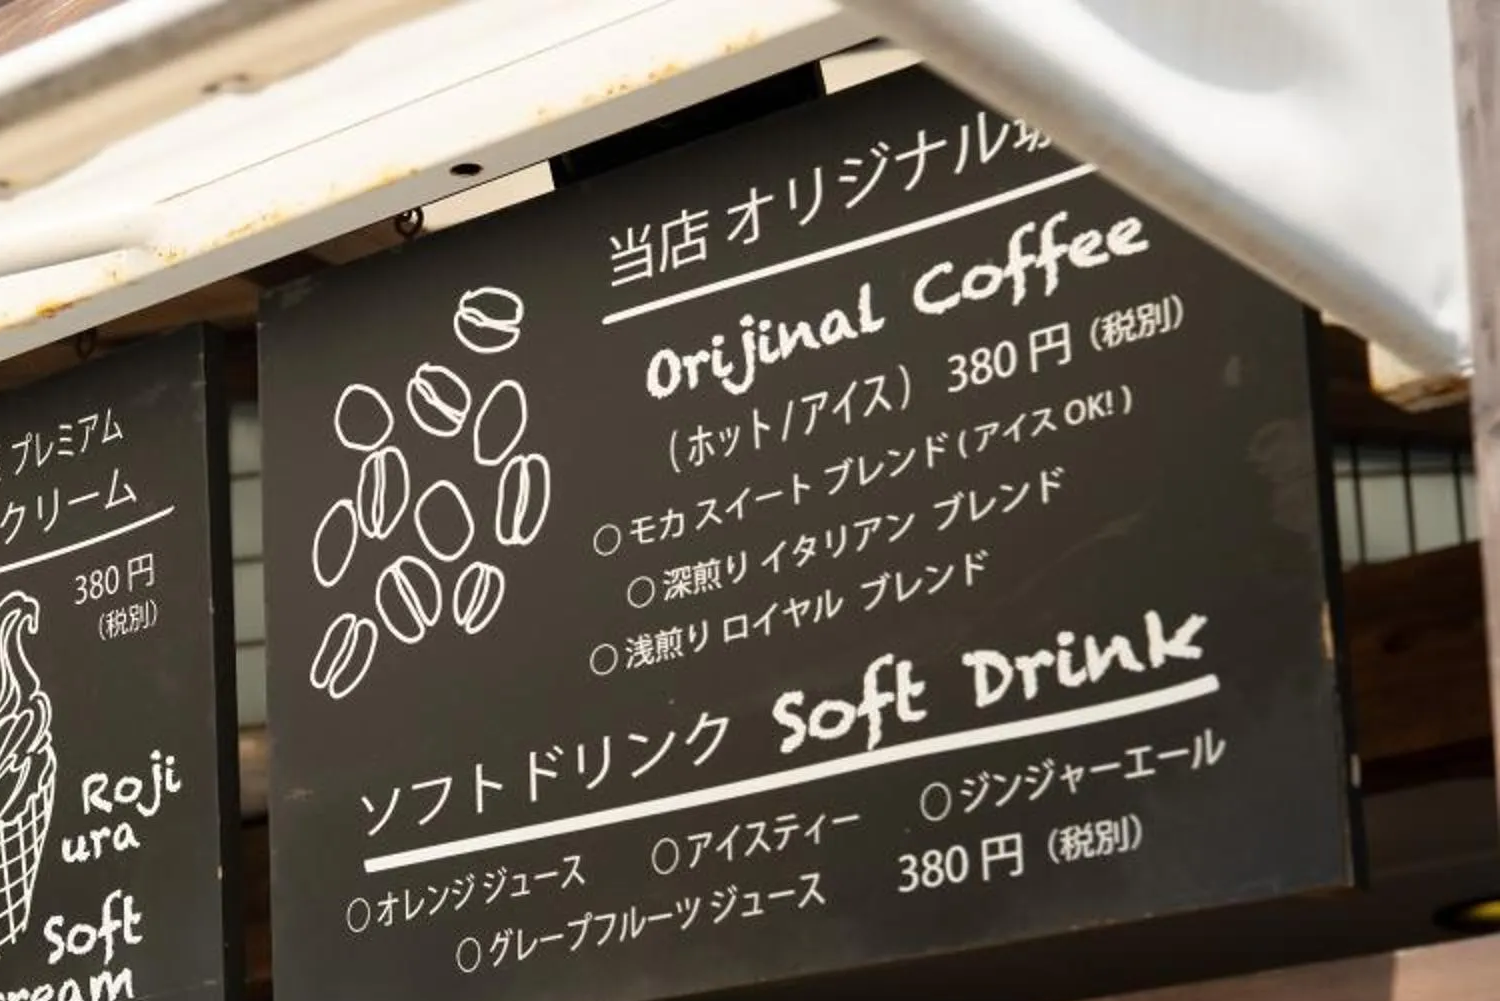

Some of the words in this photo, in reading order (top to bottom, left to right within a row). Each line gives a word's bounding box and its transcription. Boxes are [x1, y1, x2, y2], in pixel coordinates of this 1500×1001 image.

[610, 207, 709, 288] 当店
[646, 281, 886, 401] Orijinal
[912, 211, 1150, 316] Coffee
[12, 408, 123, 477] プレミアム
[761, 511, 916, 574] イタリアン
[933, 467, 1066, 534] ブレンド
[99, 600, 159, 641] (税別)
[722, 589, 844, 646] ロイヤル
[861, 549, 990, 613] ブレンド
[772, 653, 927, 754] Soft
[961, 609, 1208, 708] Drink
[82, 749, 182, 817] Roji
[360, 711, 730, 837] ソフトドリンク
[960, 728, 1227, 814] ジンジャーエール
[61, 822, 141, 863] ura
[687, 812, 861, 870] アイスティー
[43, 889, 143, 965] Soft
